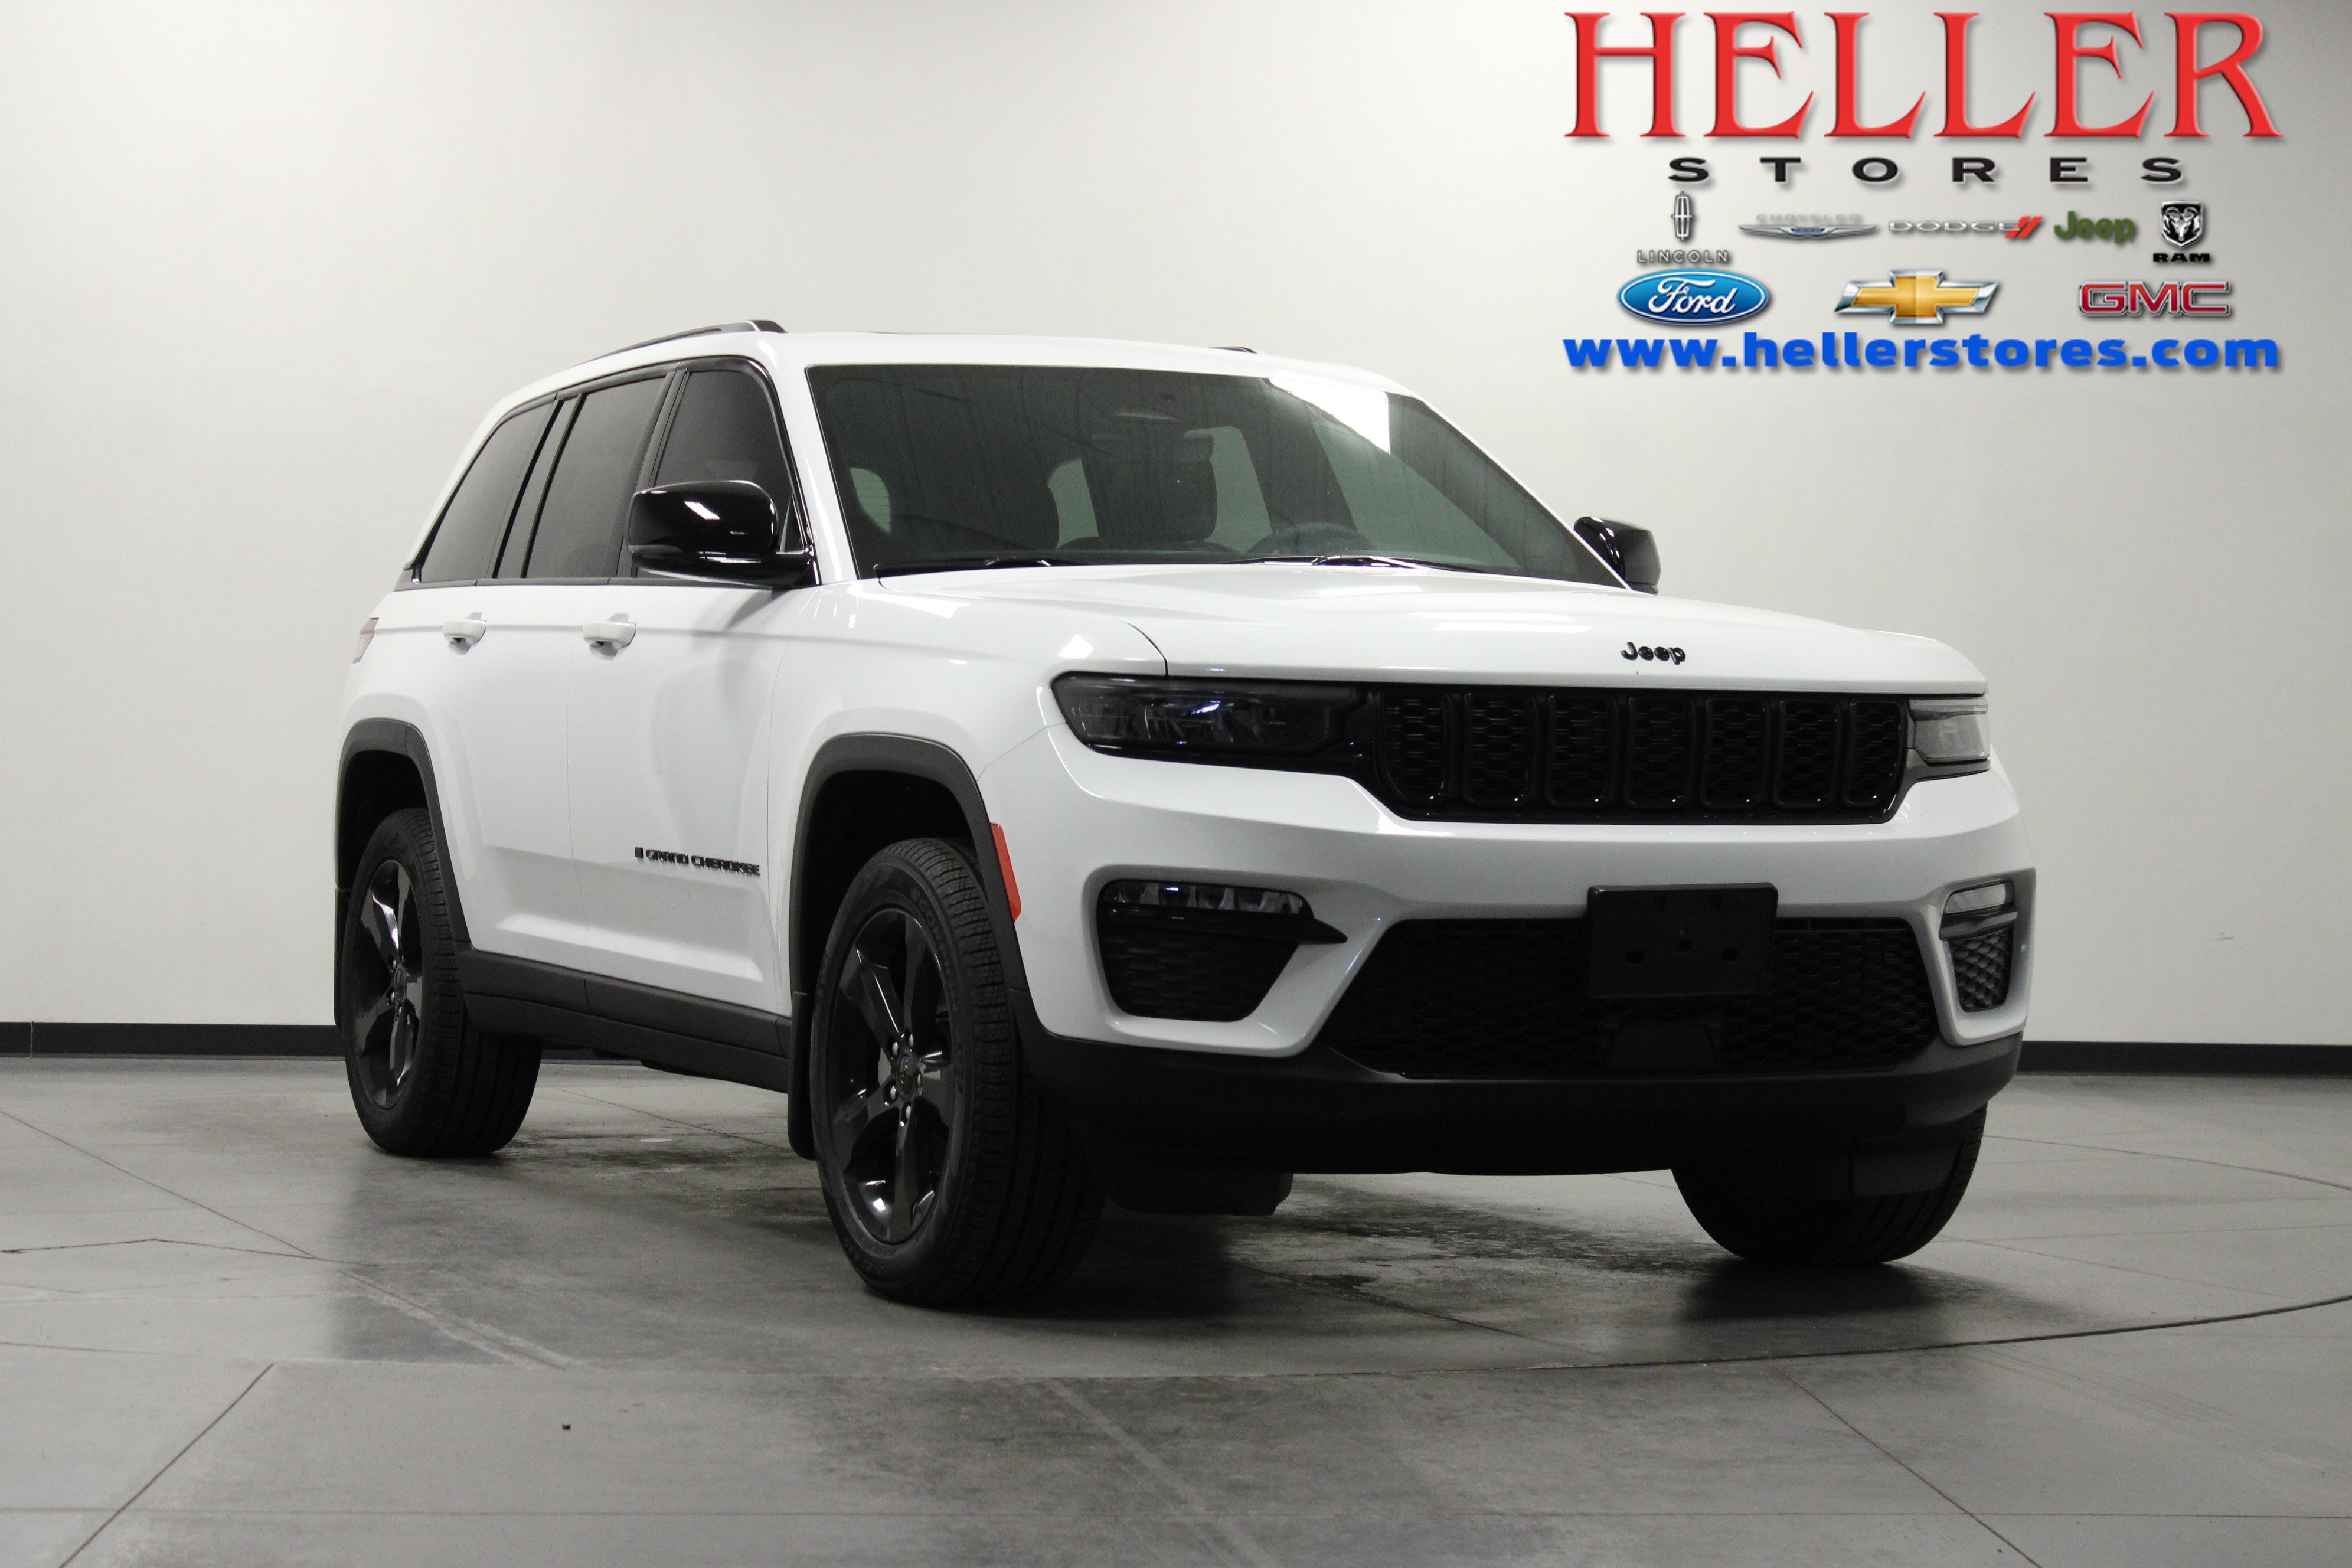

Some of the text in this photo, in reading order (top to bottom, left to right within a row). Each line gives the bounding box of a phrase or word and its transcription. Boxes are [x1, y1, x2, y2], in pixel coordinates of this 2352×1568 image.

[1620, 641, 1686, 665] Jeep
[645, 849, 761, 876] GRAND CHEROKEE
